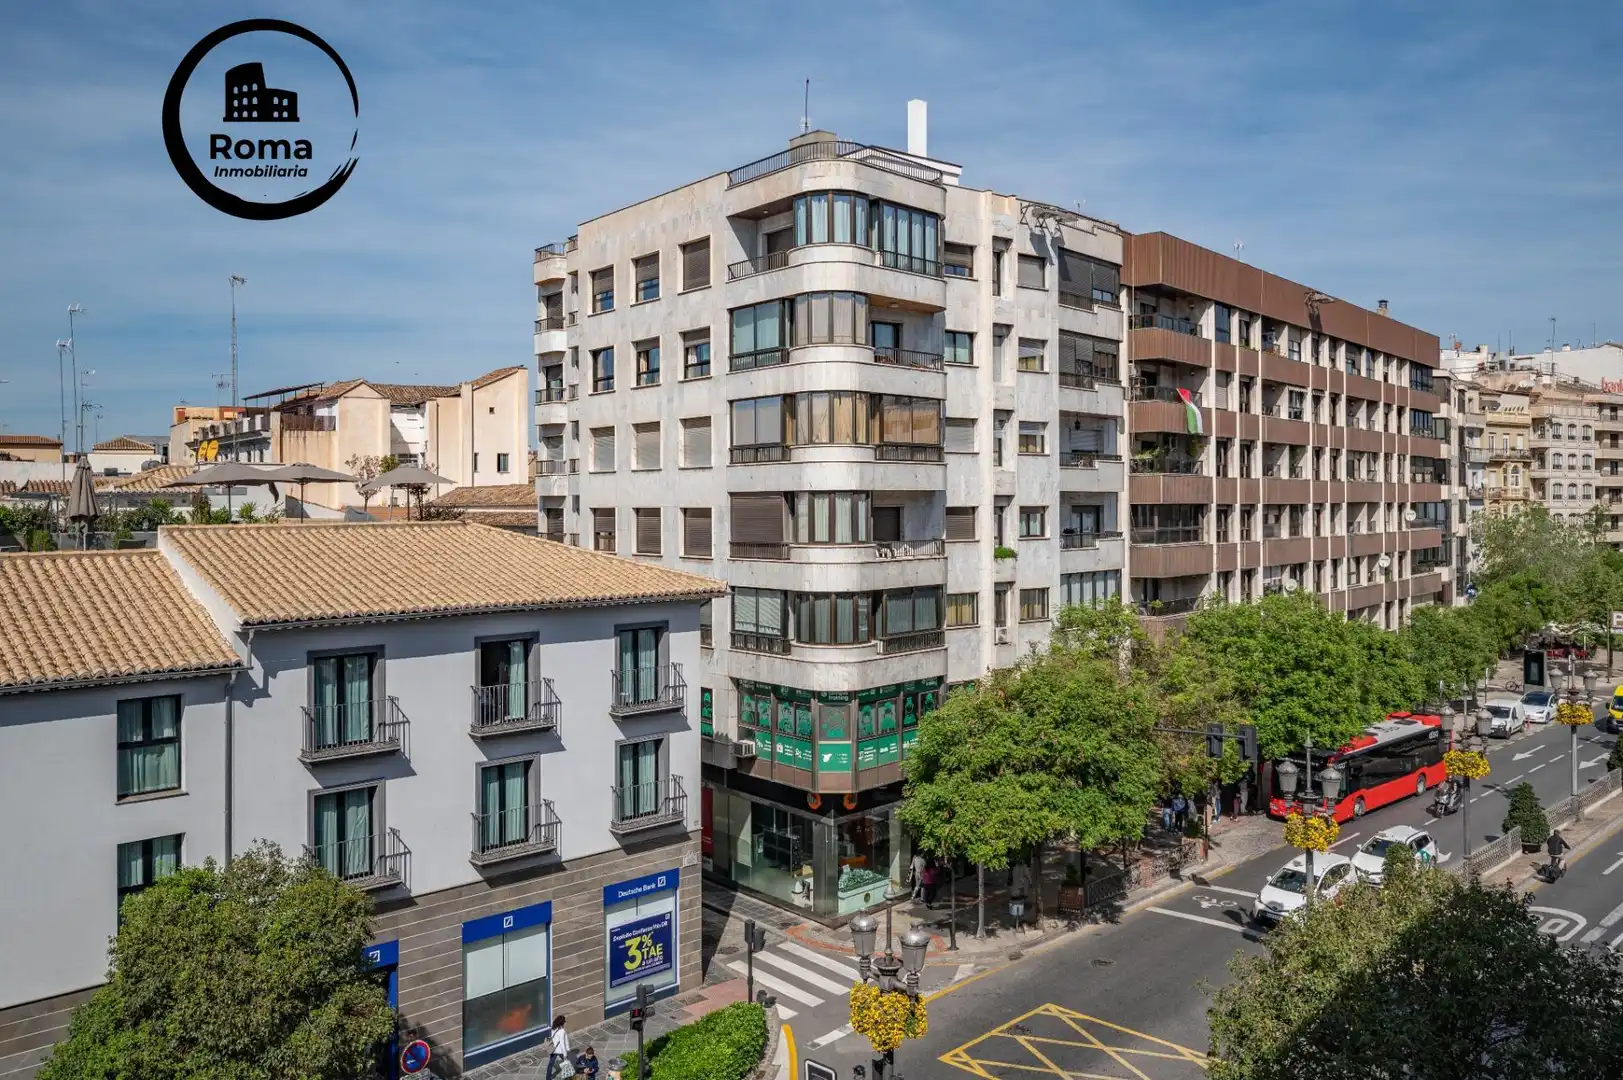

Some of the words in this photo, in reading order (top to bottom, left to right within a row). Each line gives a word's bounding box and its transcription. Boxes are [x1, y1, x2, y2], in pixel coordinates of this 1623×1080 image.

[618, 886, 642, 898] Deutsche
[642, 882, 656, 891] Bank
[642, 943, 663, 960] TAE
